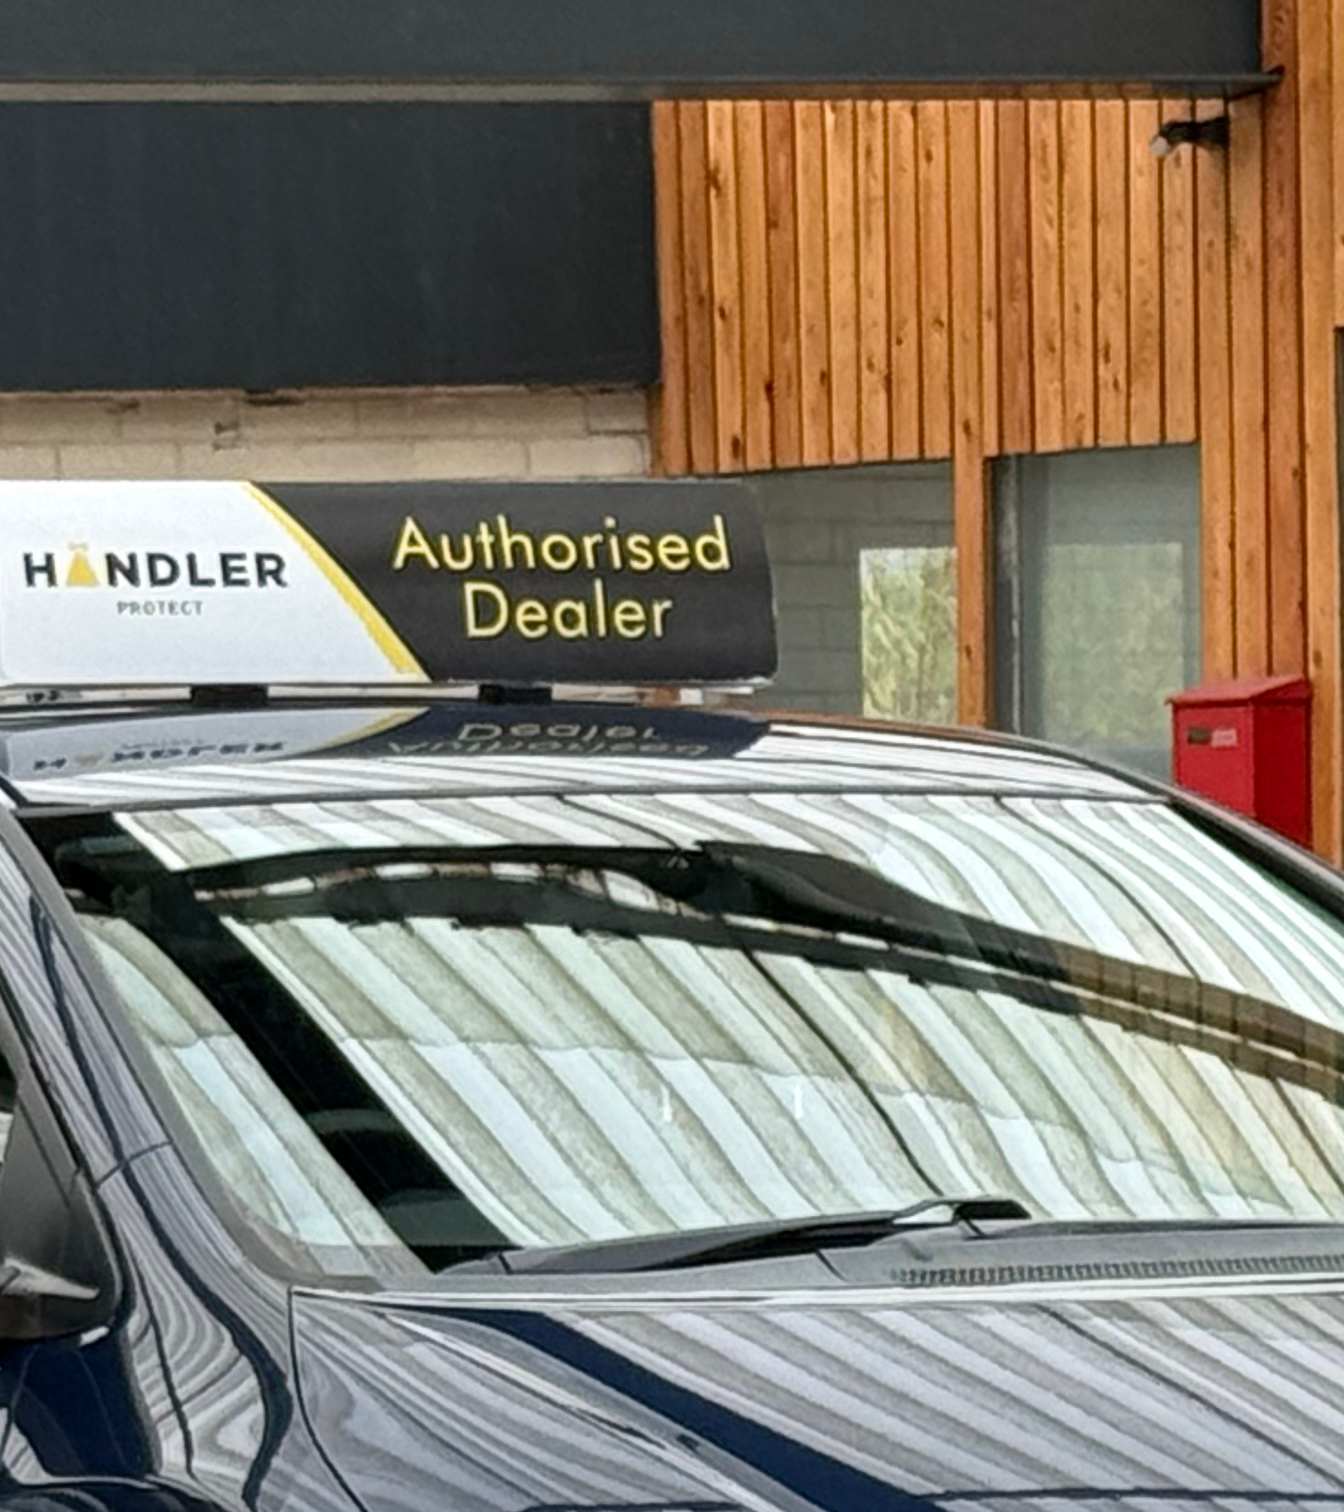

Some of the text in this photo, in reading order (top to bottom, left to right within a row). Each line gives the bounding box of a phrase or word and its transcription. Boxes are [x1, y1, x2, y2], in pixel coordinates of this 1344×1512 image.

[393, 515, 730, 572] Authorised
[117, 601, 202, 616] PROTECT
[464, 582, 673, 639] Dealer
